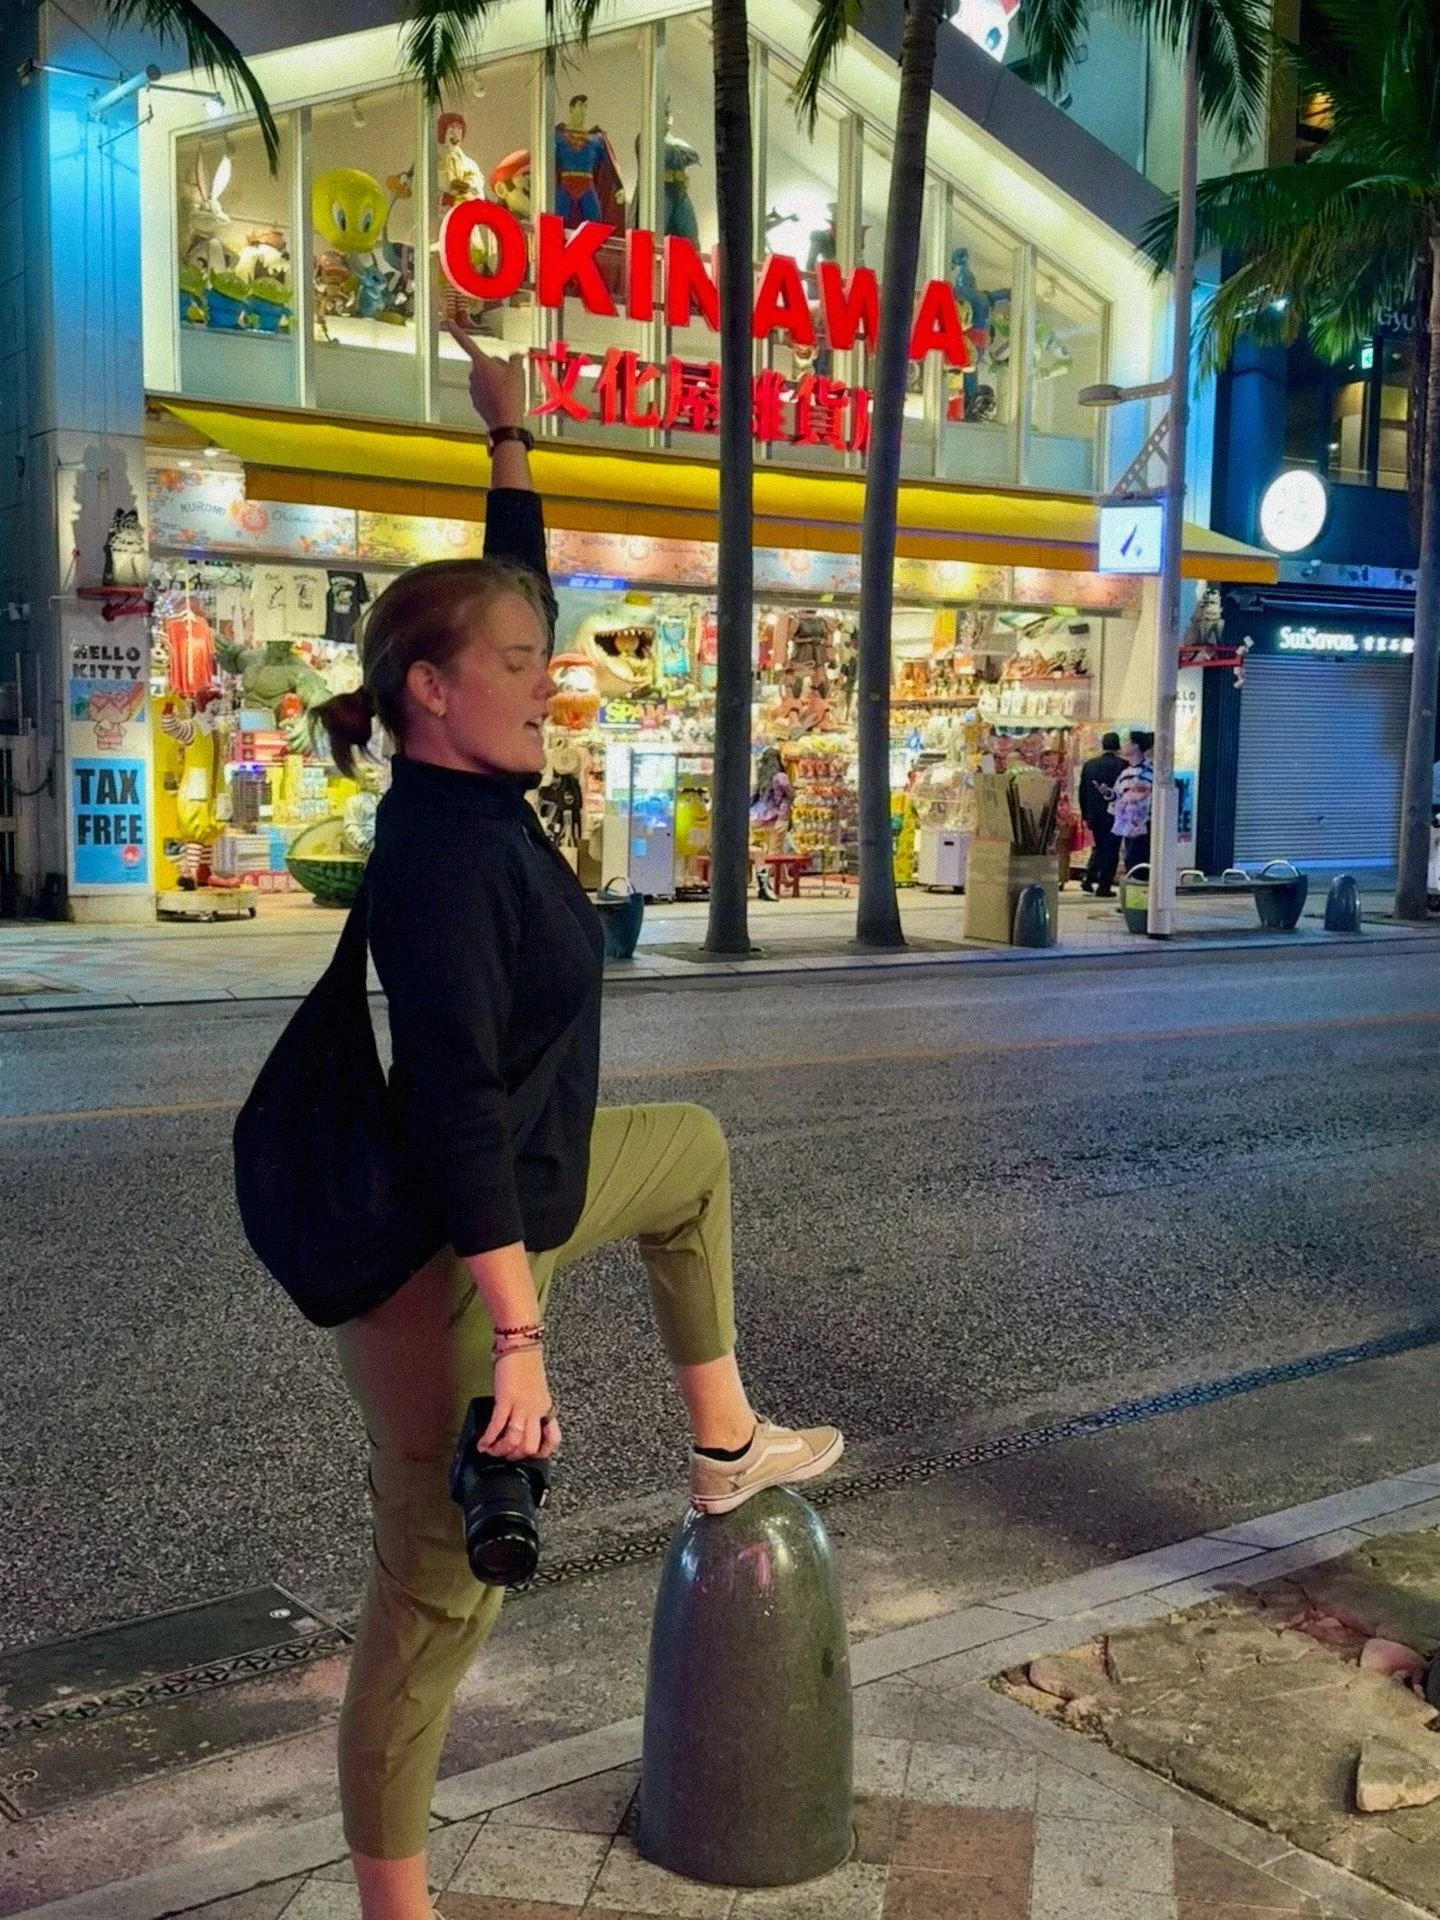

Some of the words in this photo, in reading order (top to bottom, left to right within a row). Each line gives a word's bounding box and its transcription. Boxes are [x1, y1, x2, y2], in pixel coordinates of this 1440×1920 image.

[439, 199, 968, 367] OKINAWA
[73, 645, 140, 661] HELLO
[72, 663, 141, 680] KITTY
[605, 702, 666, 726] SPAM
[75, 768, 140, 805] TAX
[78, 814, 143, 845] FREE
